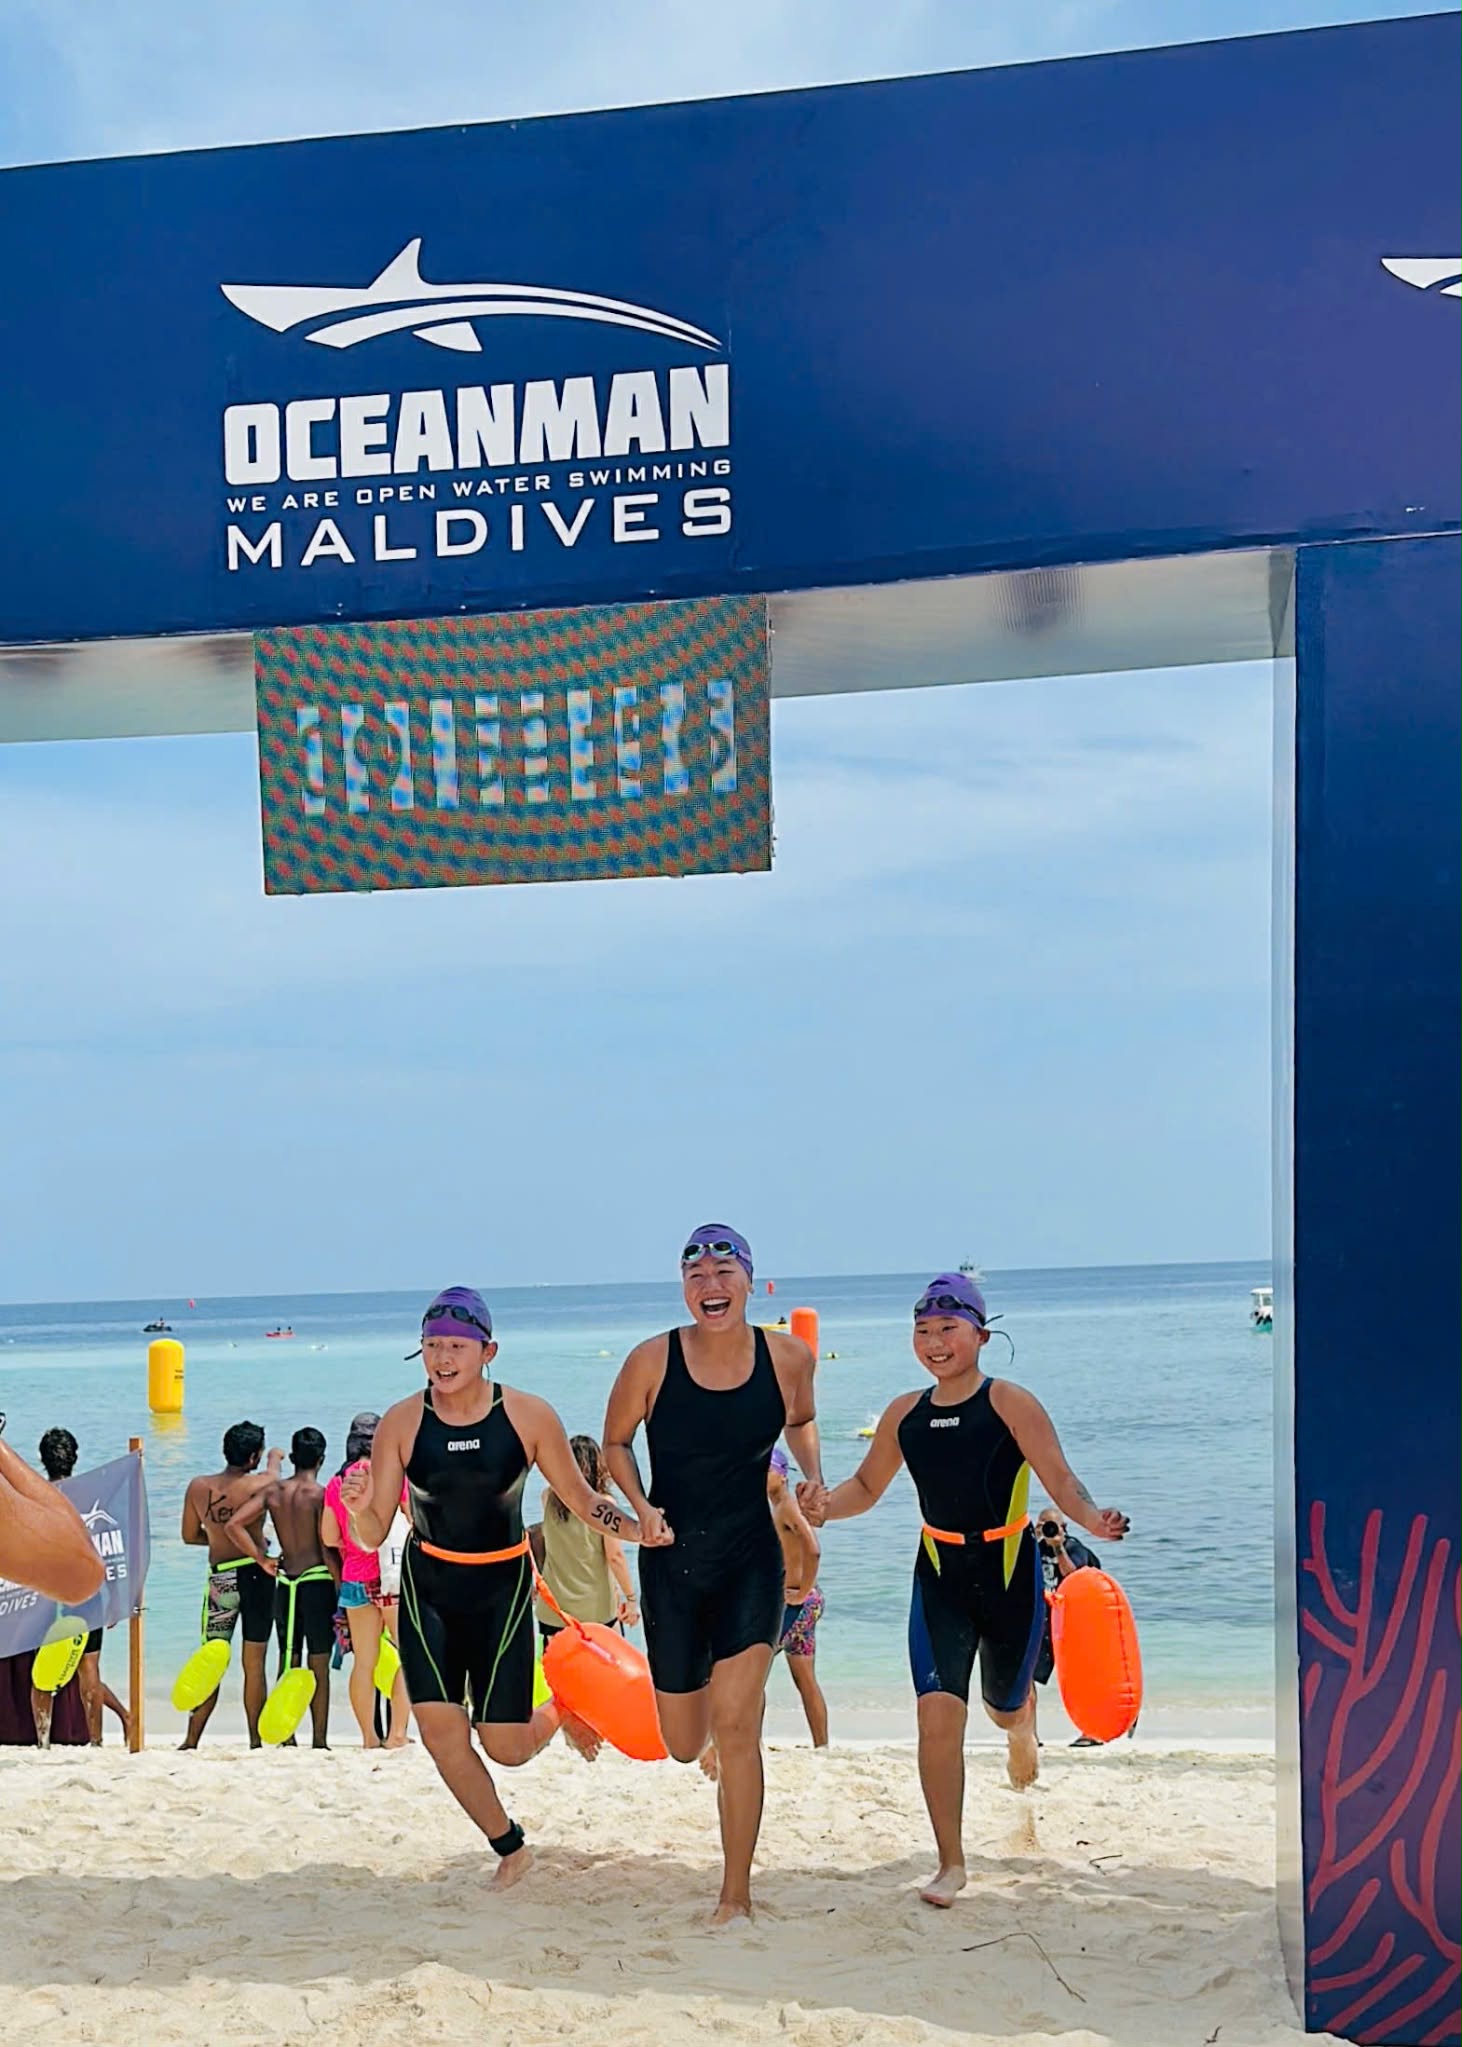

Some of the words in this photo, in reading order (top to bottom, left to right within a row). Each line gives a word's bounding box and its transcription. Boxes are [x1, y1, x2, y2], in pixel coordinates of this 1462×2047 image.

[224, 363, 730, 485] OCEANMAN
[227, 496, 267, 513] WE
[282, 491, 340, 510] ARE
[356, 484, 436, 505] OPEN
[453, 472, 552, 498] WATER
[569, 459, 731, 488] SWIMMING
[227, 487, 731, 571] MALDIVES
[448, 1439, 480, 1451] arena
[930, 1416, 960, 1428] arena
